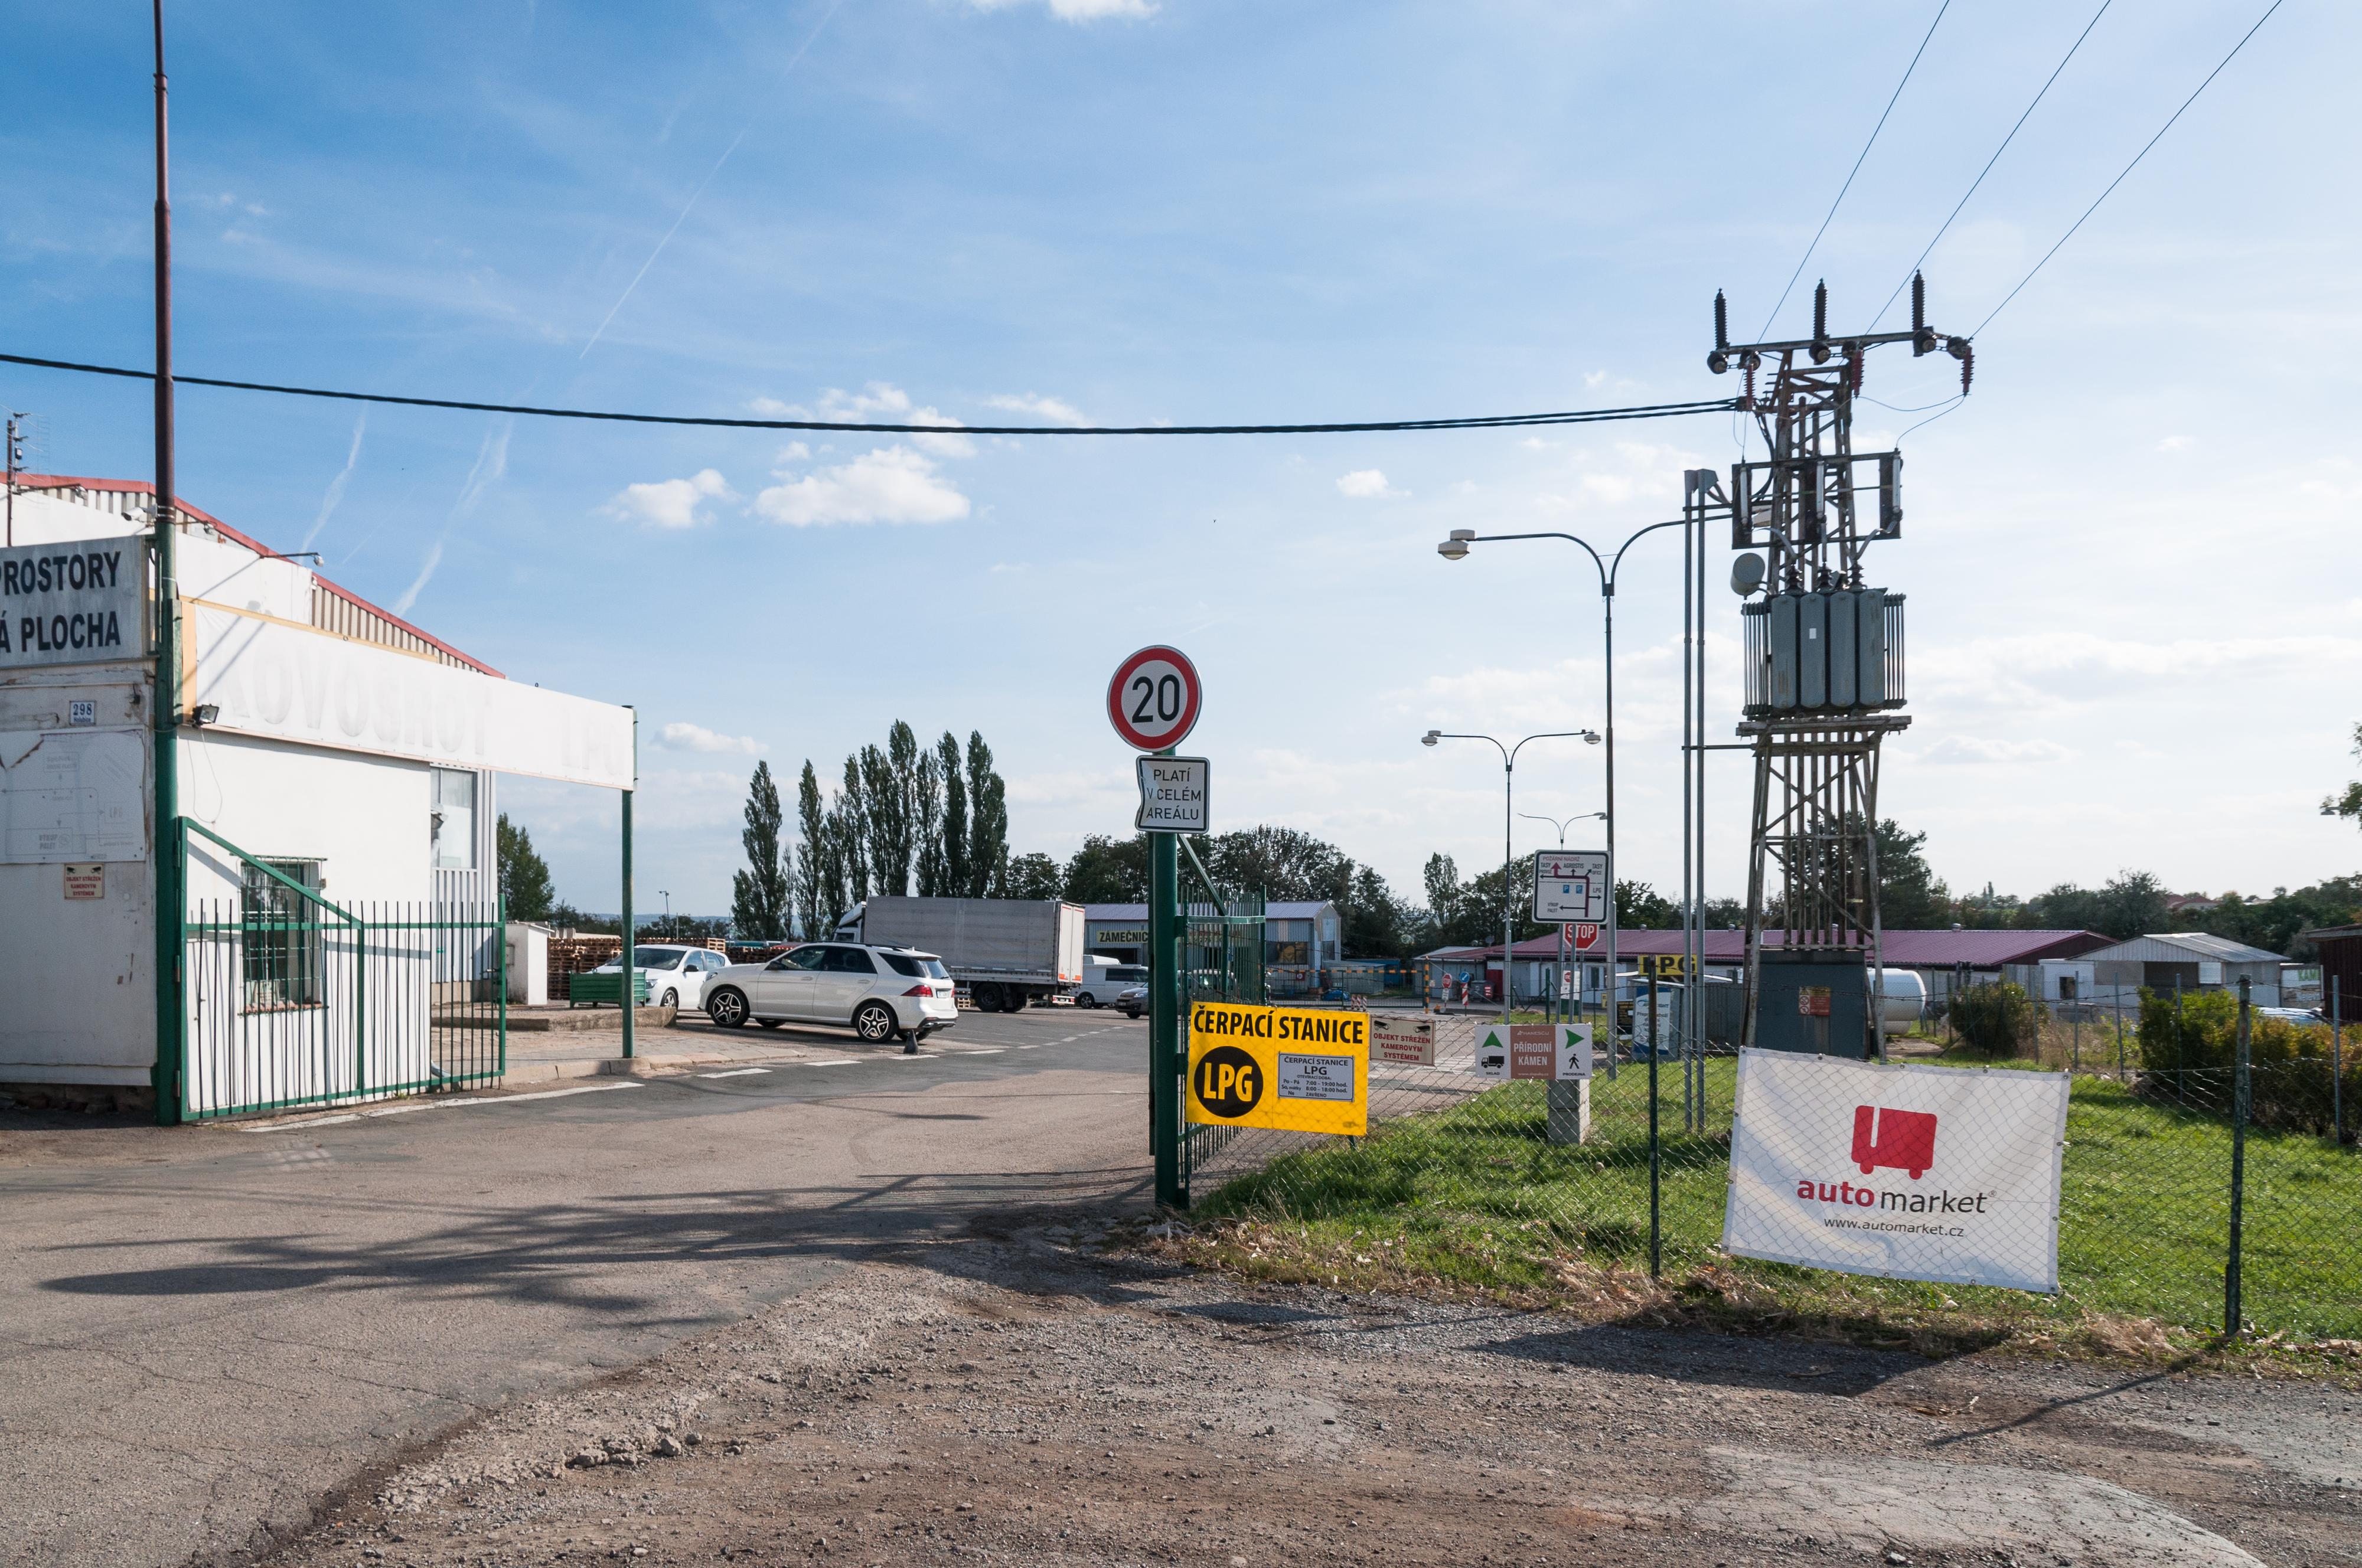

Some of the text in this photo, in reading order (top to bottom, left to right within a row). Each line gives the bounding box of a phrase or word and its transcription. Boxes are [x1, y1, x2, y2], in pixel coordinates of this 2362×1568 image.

[0, 551, 121, 596] ROSTORY
[21, 610, 121, 652] PLOCHA
[1132, 674, 1180, 724] 20
[73, 703, 92, 716] 298
[1153, 767, 1190, 782] PLATÍ
[1147, 786, 1201, 802] V CELÉM
[1146, 805, 1199, 821] AREÁLU
[1567, 925, 1594, 939] STOP
[1193, 1005, 1363, 1044] ČERPACÍ STANICE
[1374, 1033, 1431, 1044] OBJEKT STŘEŽEN
[1381, 1043, 1423, 1053] KAMEROVÝM
[1513, 1041, 1552, 1053] PŘÍRODNÍ
[1384, 1051, 1420, 1061] SYSTÉMEM
[1518, 1054, 1548, 1066] KÁMEN
[1304, 1066, 1327, 1075] LPG
[1203, 1063, 1252, 1102] LPG
[1823, 1218, 1965, 1237] www.automarket.cz
